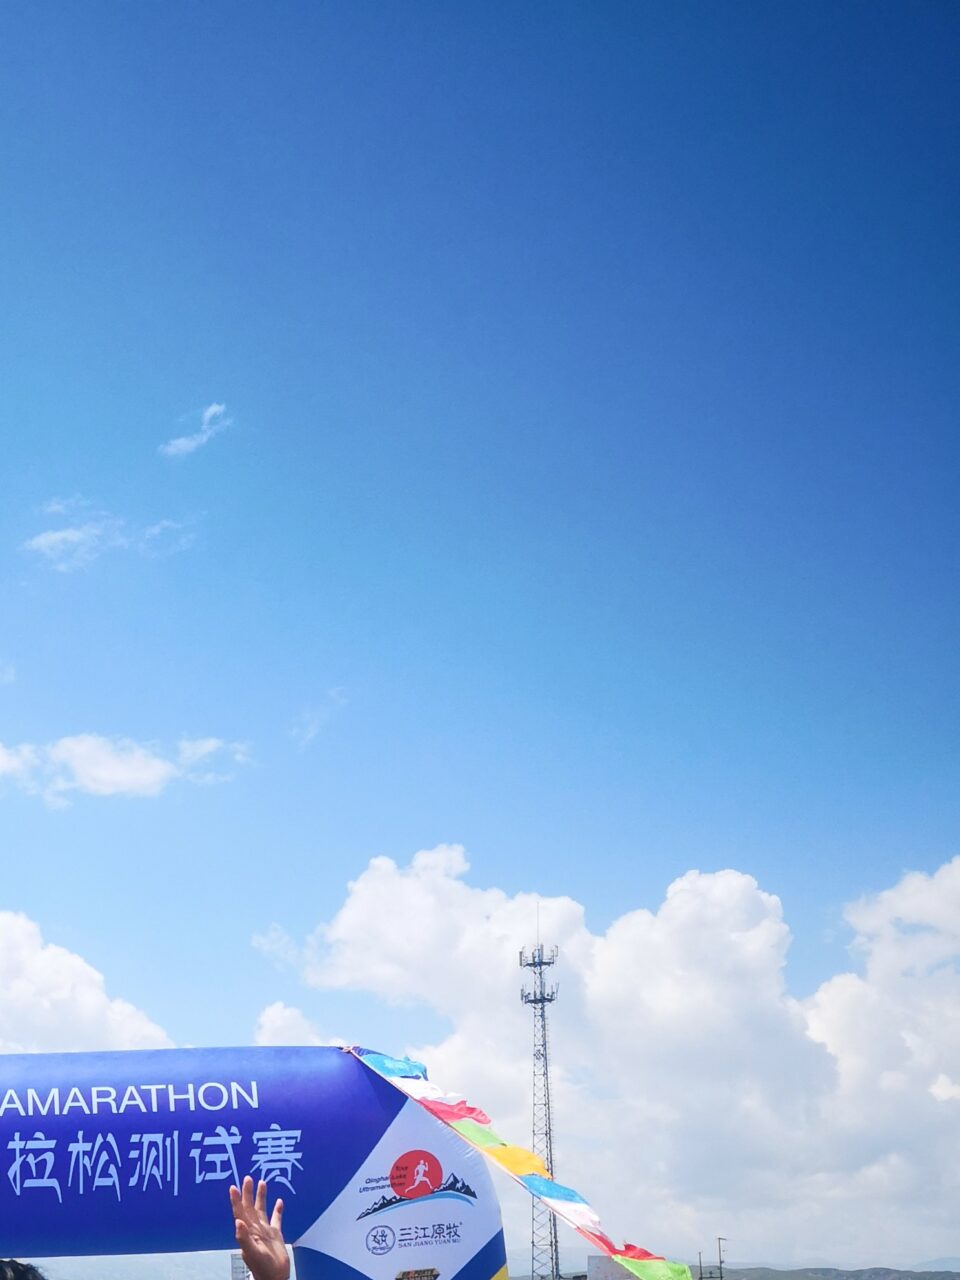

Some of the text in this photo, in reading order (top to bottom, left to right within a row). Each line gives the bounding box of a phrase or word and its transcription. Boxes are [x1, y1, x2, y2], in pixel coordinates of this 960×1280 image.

[398, 1223, 461, 1242] 三江原牧
[413, 1239, 434, 1247] JIANG
